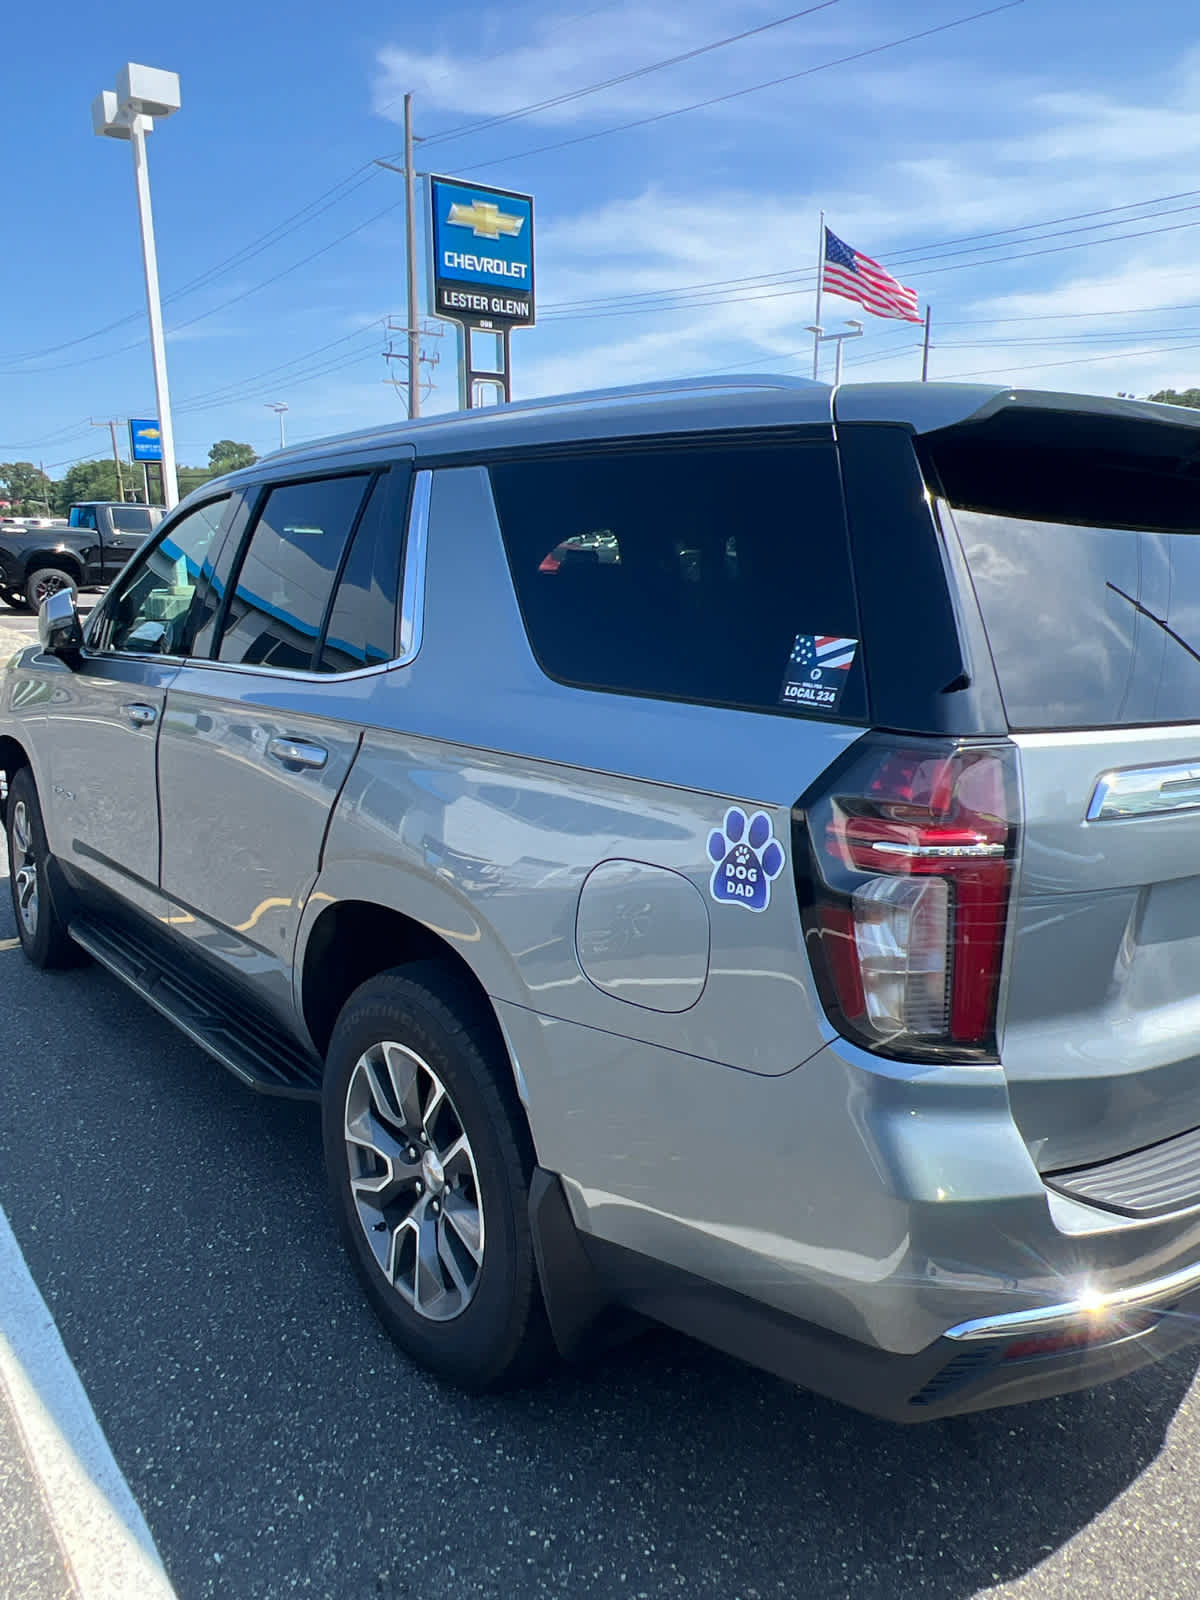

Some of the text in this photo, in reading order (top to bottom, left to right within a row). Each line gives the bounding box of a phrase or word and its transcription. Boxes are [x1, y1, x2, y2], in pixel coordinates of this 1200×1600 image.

[444, 251, 527, 279] CHEVROLET
[444, 291, 529, 316] LESTER GLENN
[784, 685, 816, 700] LOCAL
[816, 690, 836, 703] 234
[726, 863, 758, 882] DOG
[726, 880, 754, 898] DAD
